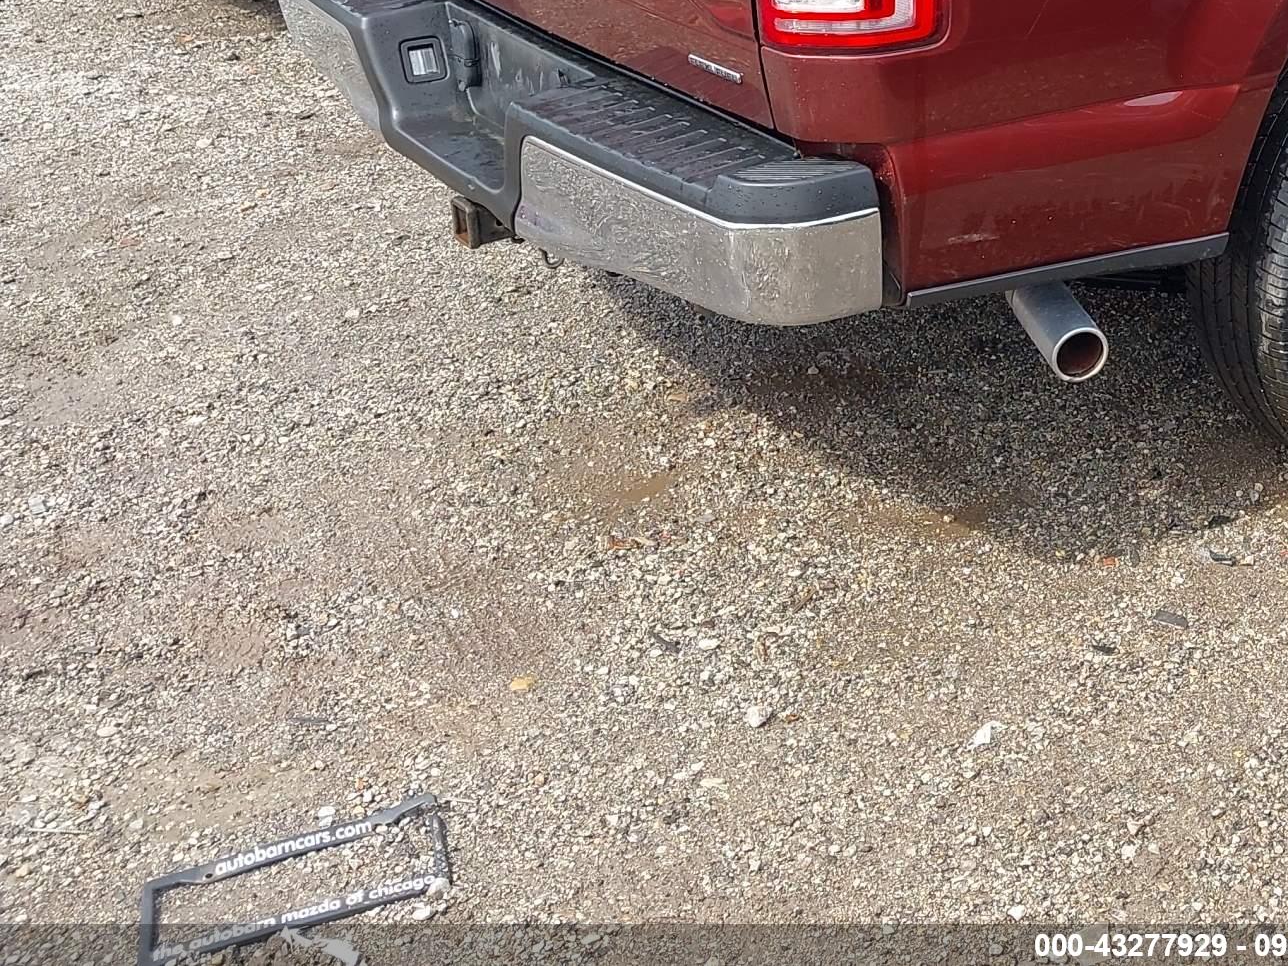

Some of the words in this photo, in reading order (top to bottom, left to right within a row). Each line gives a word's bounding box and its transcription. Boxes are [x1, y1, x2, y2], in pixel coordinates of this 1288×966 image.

[215, 821, 372, 876] autobarncars.com
[188, 918, 277, 950] autobarn
[281, 898, 342, 924] mazda
[345, 889, 364, 906] of
[368, 875, 436, 900] chicago
